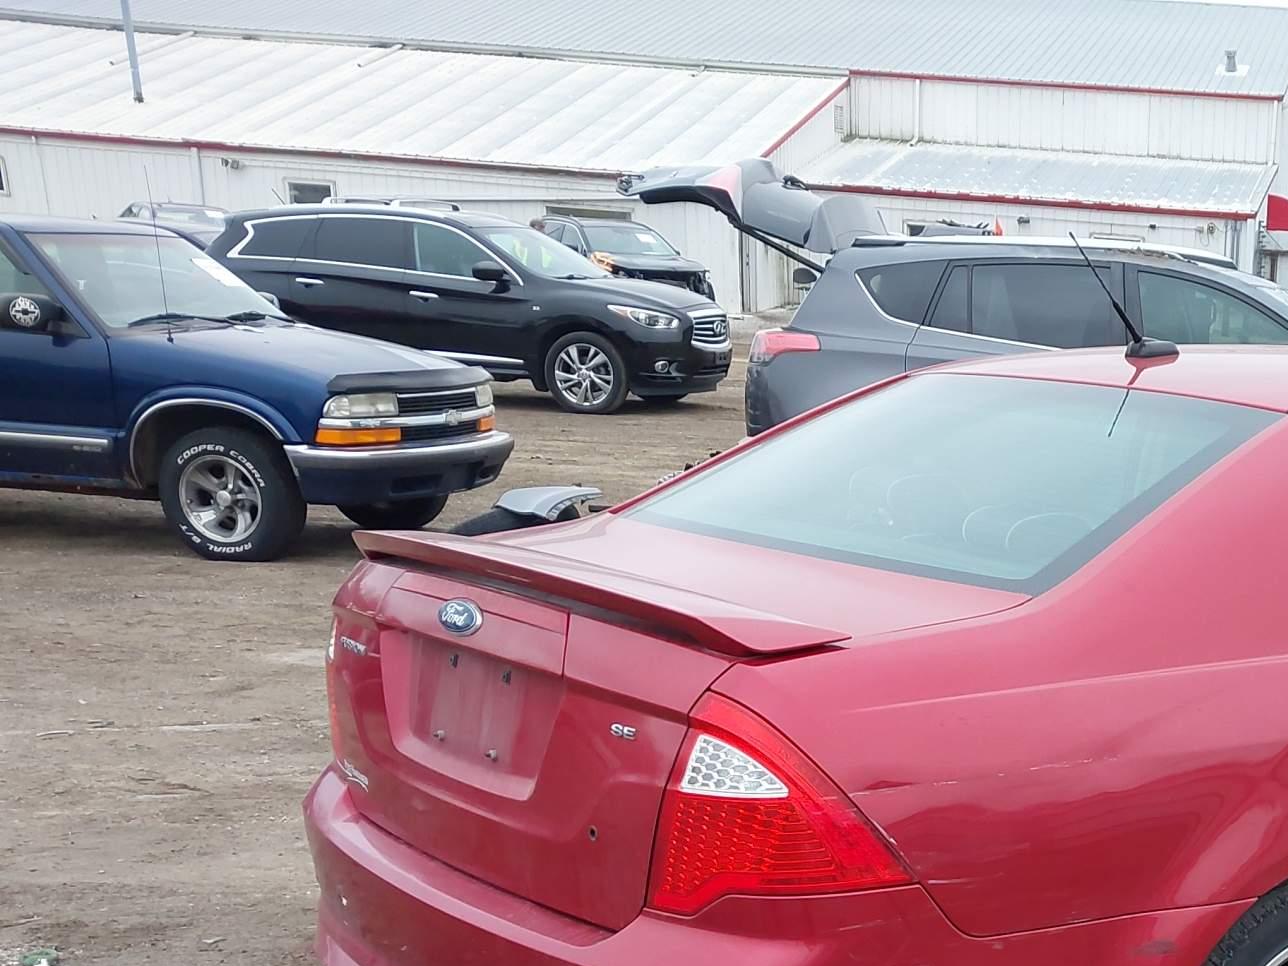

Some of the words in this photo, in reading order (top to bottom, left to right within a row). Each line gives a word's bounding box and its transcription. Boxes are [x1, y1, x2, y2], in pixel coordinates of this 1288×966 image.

[176, 443, 225, 465] COOPER
[229, 449, 265, 487] COBRA
[206, 541, 253, 553] RADIAL
[441, 602, 468, 626] Ford
[610, 723, 636, 740] SE
